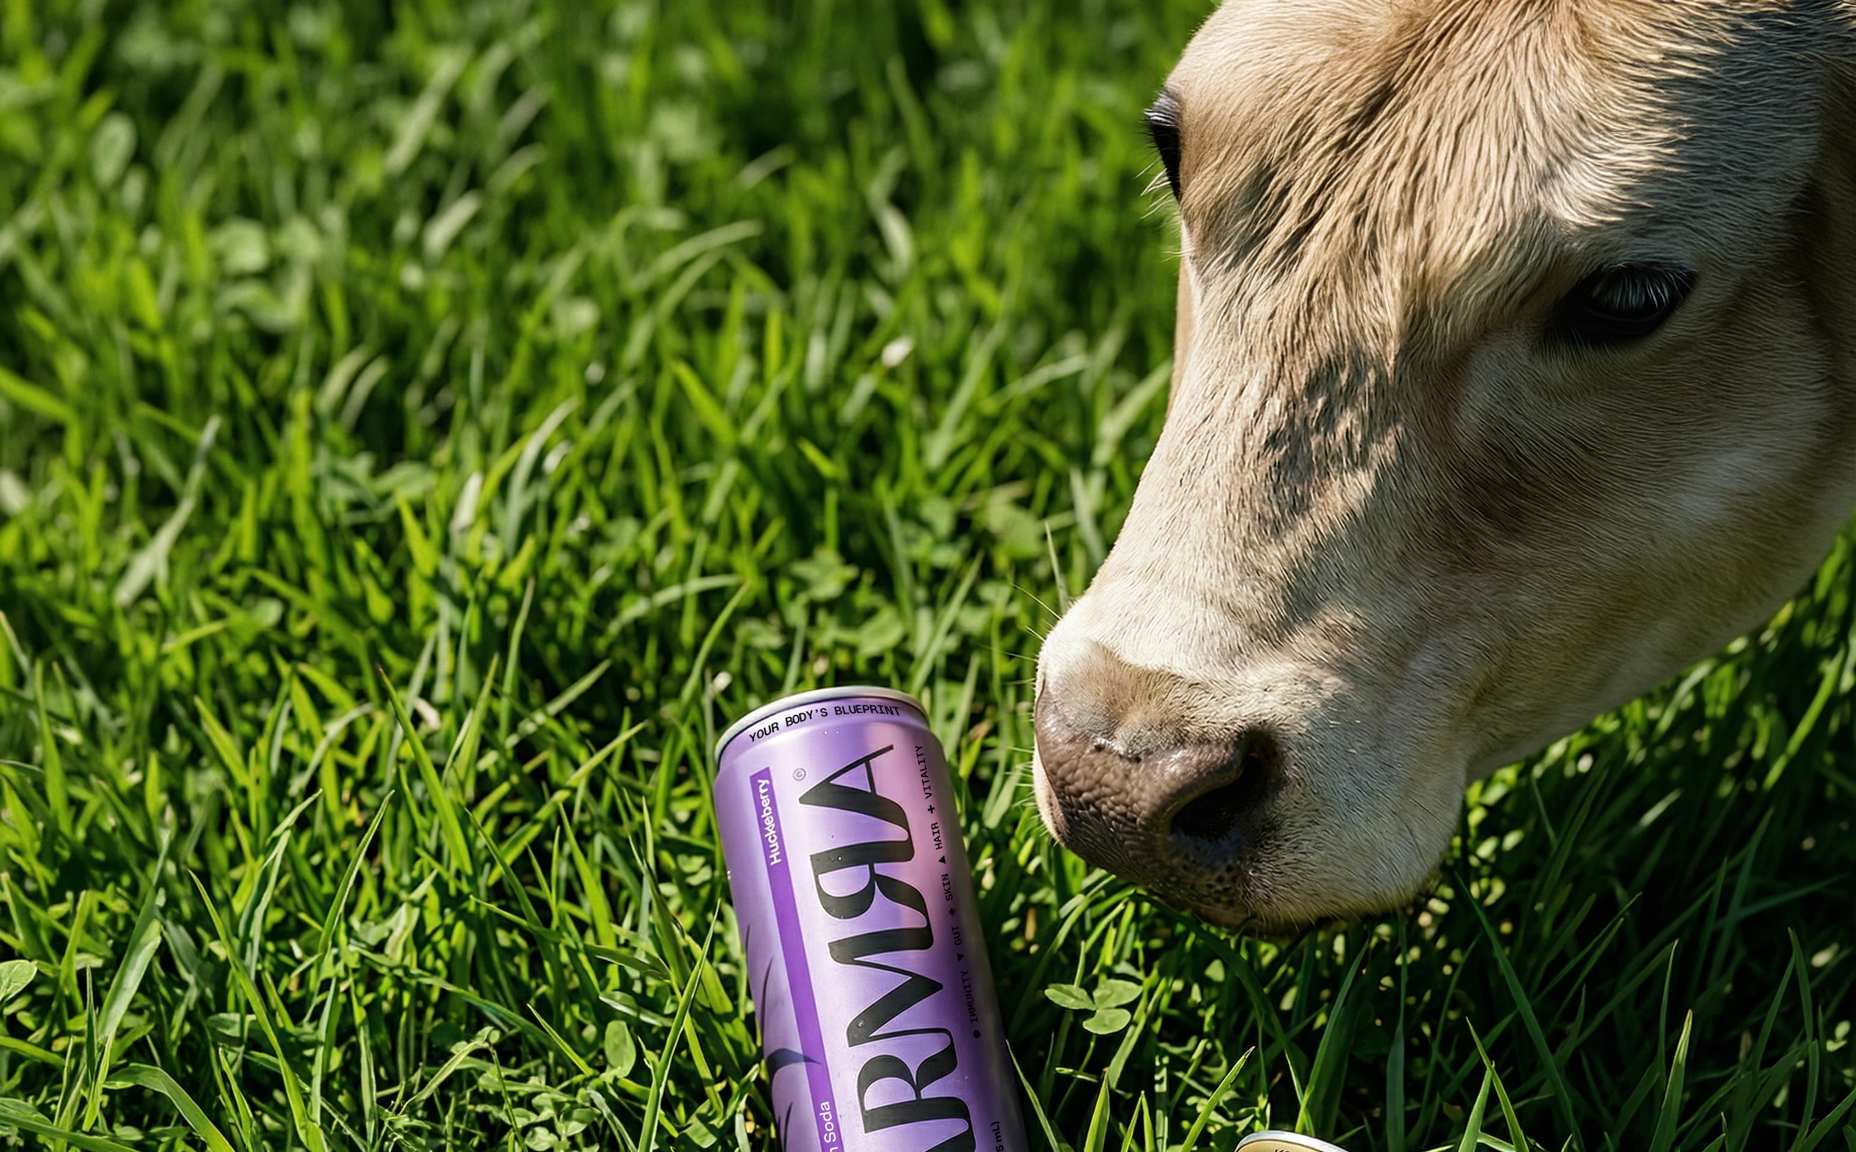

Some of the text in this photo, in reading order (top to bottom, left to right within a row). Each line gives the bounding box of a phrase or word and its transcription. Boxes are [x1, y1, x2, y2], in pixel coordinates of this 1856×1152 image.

[749, 704, 900, 743] YOUR BODY'S BLUEPRINT
[757, 778, 782, 866] Huckleberry
[915, 745, 978, 1024] IMMUNITY GUT SKIN HAIR VITALITY
[819, 1101, 836, 1143] Soda
[990, 1121, 1002, 1142] mL)
